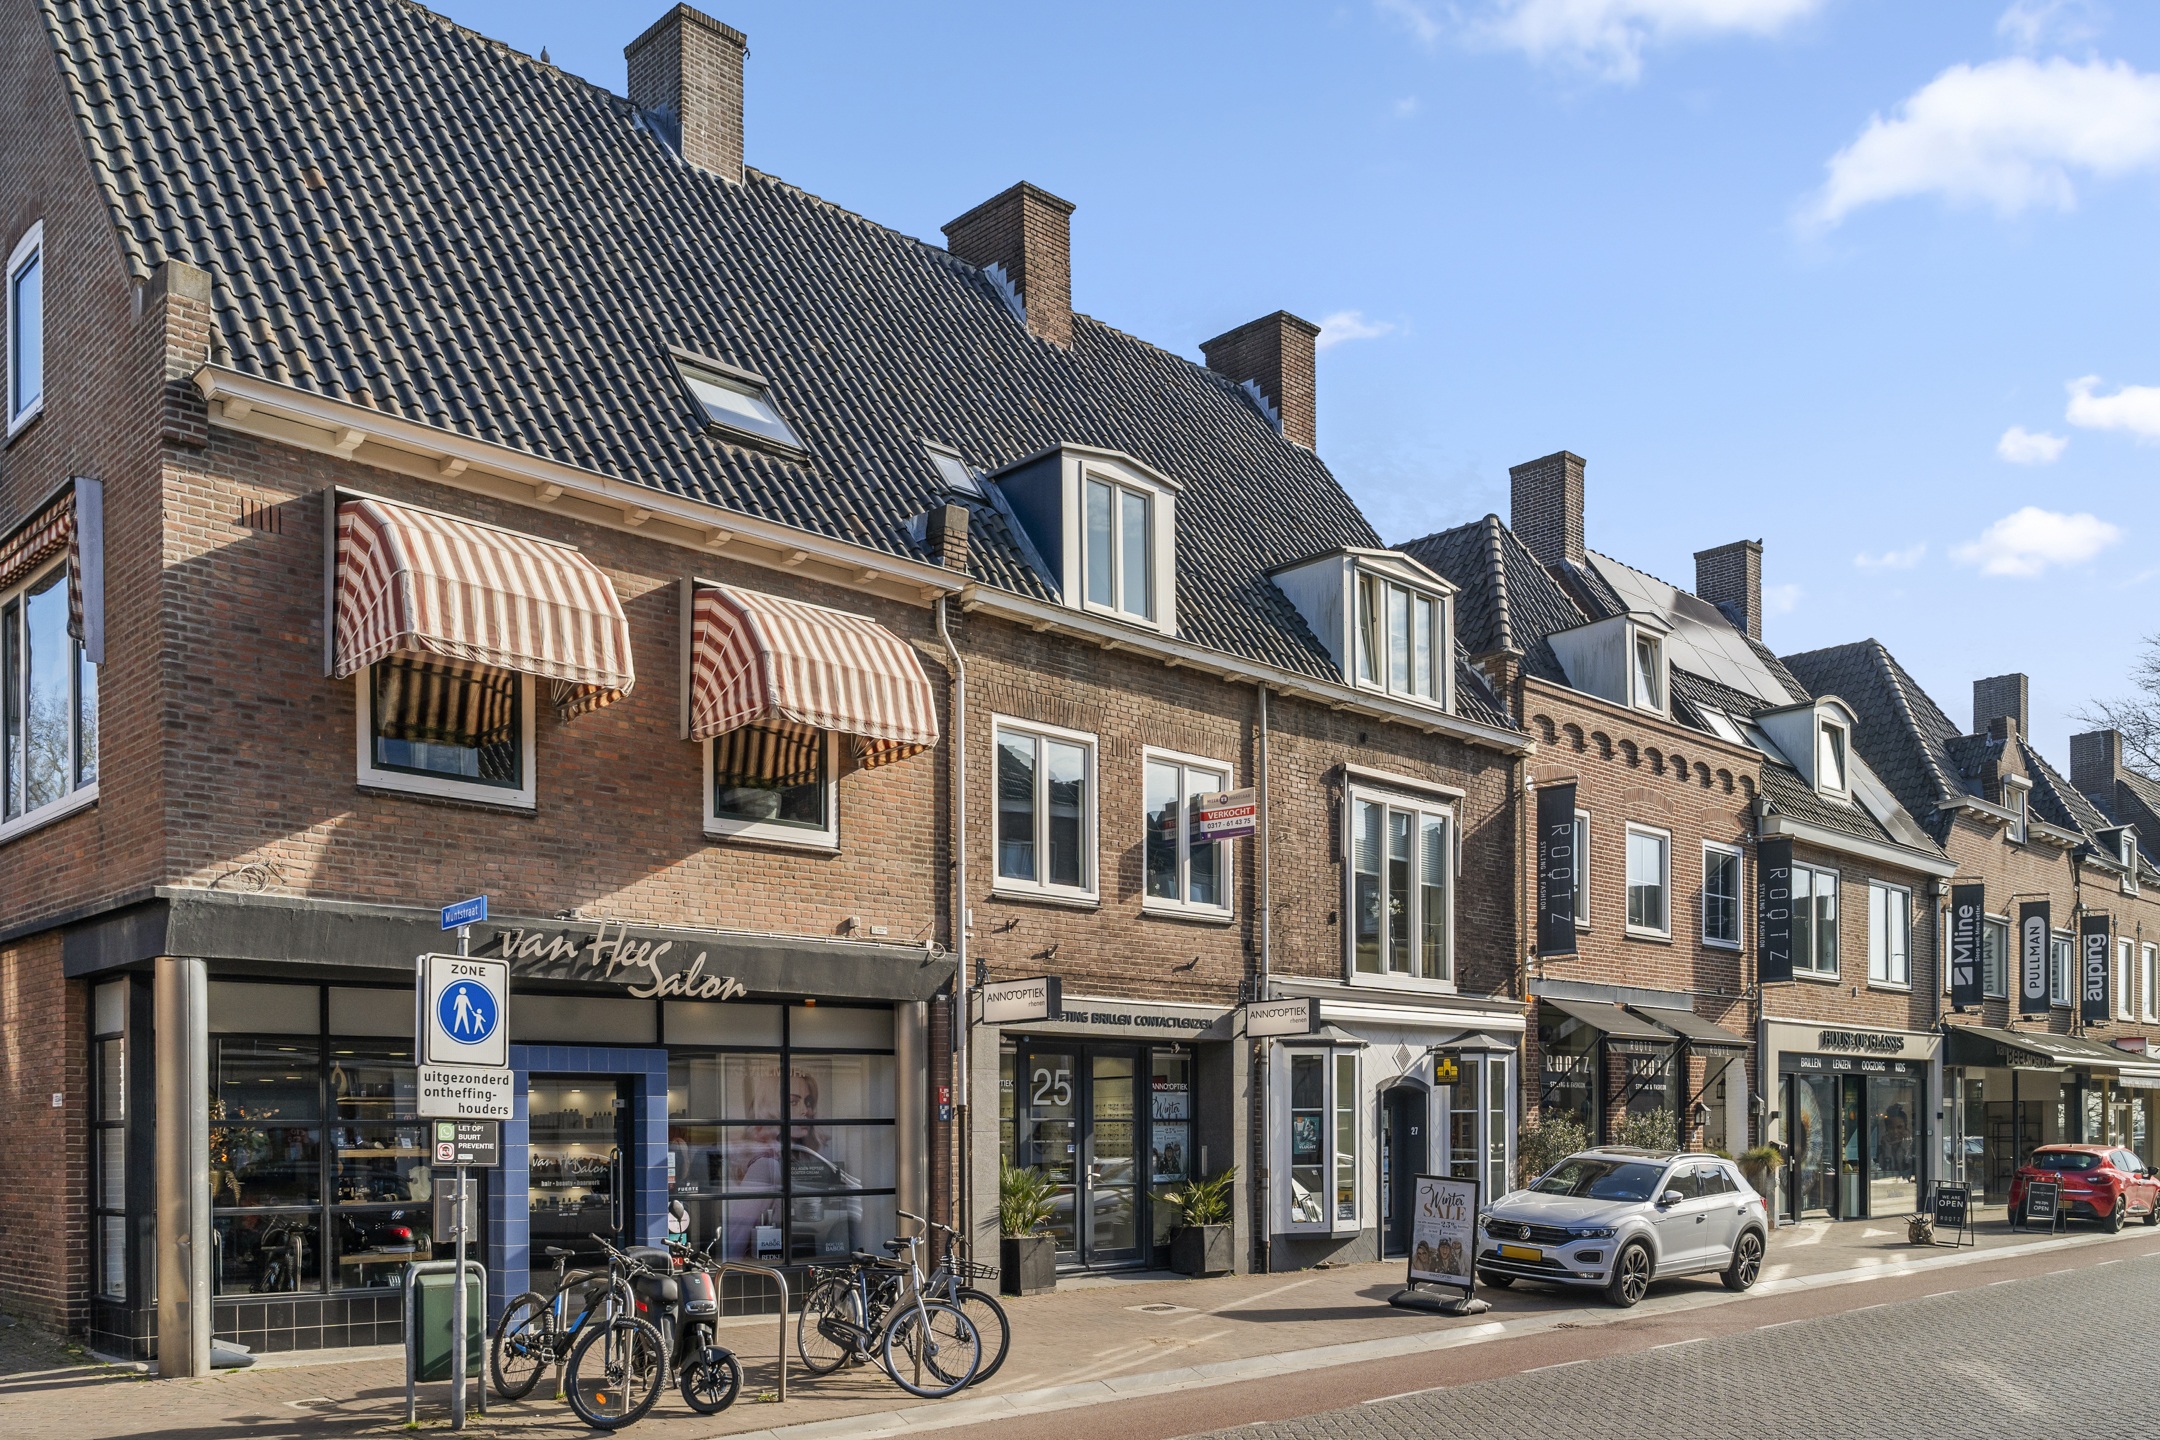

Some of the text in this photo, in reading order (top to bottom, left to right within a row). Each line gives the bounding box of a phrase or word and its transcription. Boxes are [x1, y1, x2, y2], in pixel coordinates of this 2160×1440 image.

[1207, 807, 1251, 819] VERKOCHT
[445, 905, 478, 923] Muntstraat
[501, 928, 578, 961] van
[2030, 926, 2040, 989] PULLMAN
[451, 964, 486, 977] ZONE
[628, 941, 747, 1000] Salon
[2087, 933, 2107, 1001] auping
[1091, 1012, 1131, 1026] BRILLEN
[1134, 1015, 1213, 1030] CONTACTLENZEN
[1822, 1030, 1904, 1051] HOUSE OF GLASSES
[1801, 1058, 1906, 1072] BRILLEN LENZEN OOGZORG KIDS
[424, 1071, 509, 1086] uitgezonderd
[1033, 1068, 1072, 1106] 25
[424, 1087, 497, 1102] ontheffing-
[458, 1103, 509, 1115] houders
[1411, 1127, 1418, 1135] 27
[532, 1158, 554, 1167] van
[1420, 1184, 1465, 1208] Winter
[1939, 1200, 1963, 1208] OPEN
[1423, 1203, 1467, 1221] SALE
